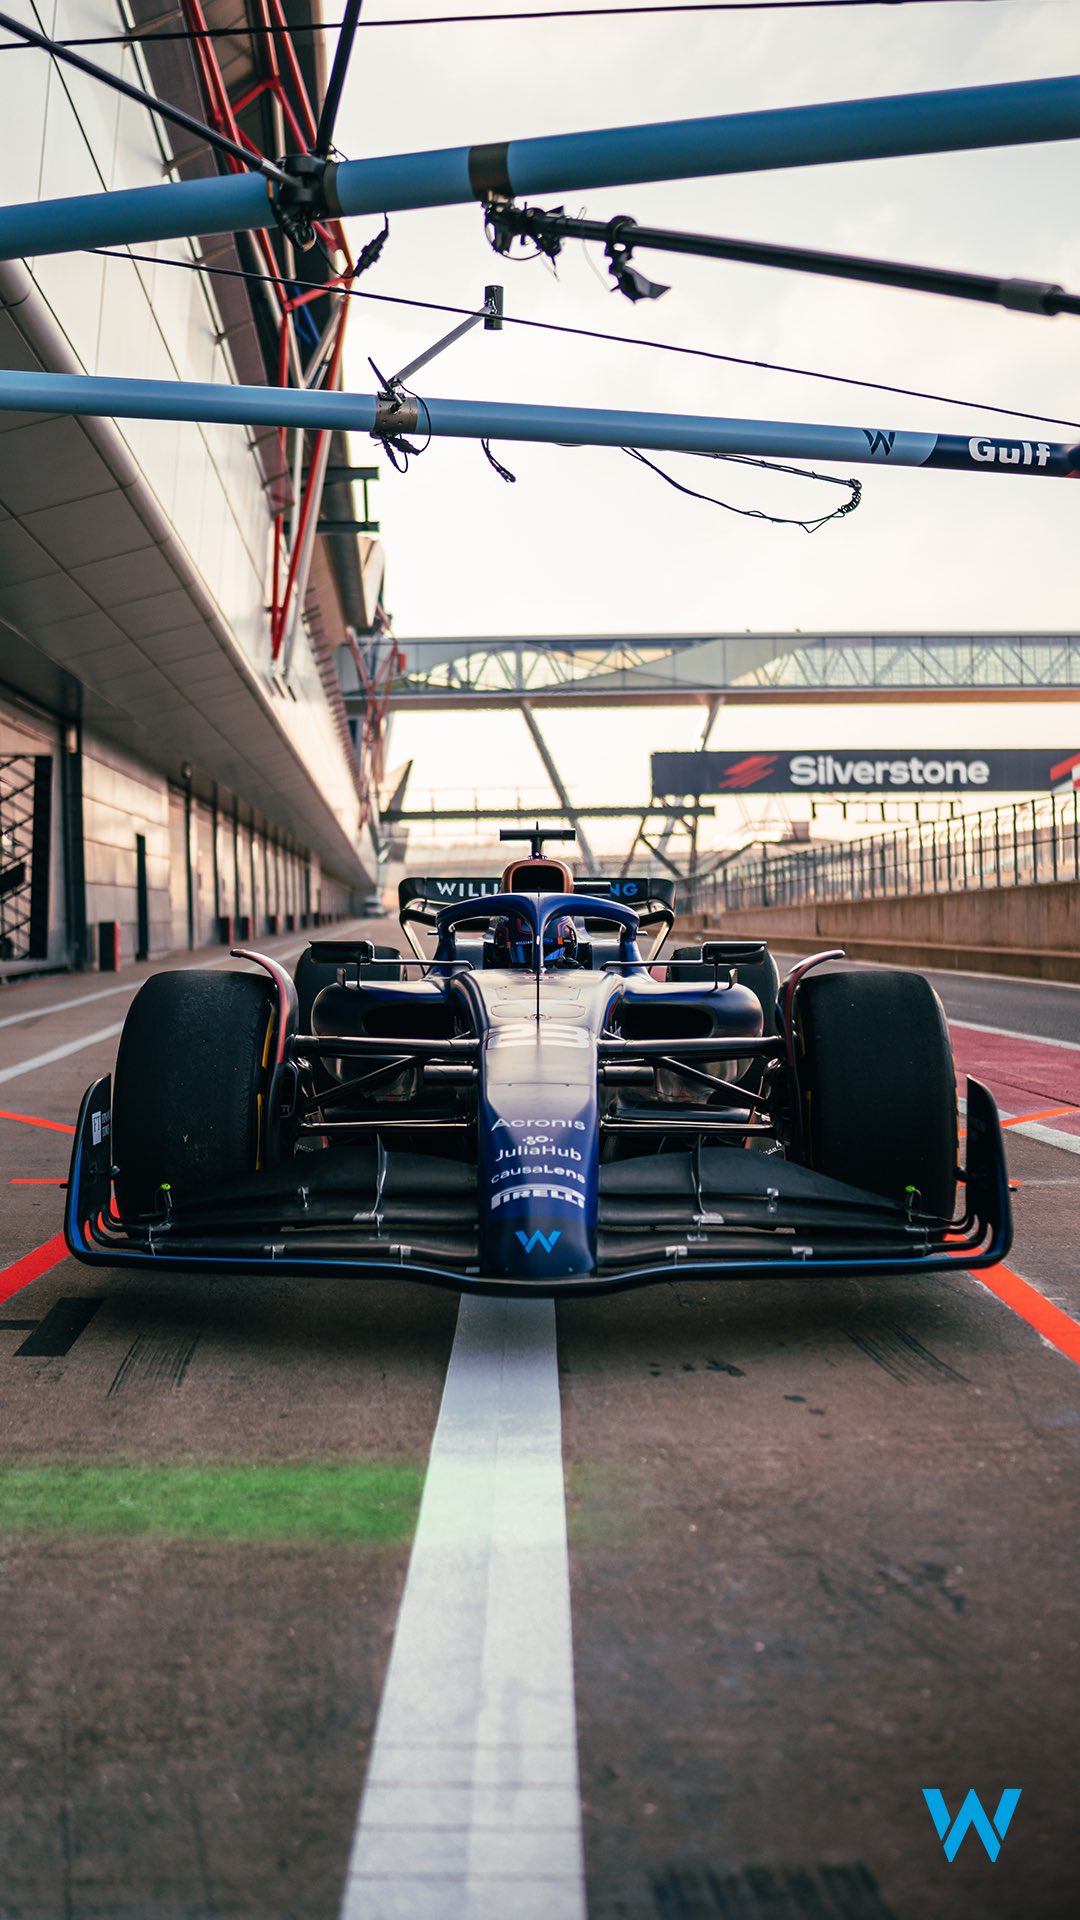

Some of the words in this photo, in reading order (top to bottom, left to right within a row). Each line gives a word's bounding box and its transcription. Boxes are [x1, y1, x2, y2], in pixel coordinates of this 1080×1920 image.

[968, 437, 1051, 467] Gulf
[789, 755, 990, 786] Silverstone
[437, 882, 500, 897] WILLI
[491, 1118, 586, 1132] Acronis
[495, 1145, 582, 1162] JuliaHub
[491, 1164, 586, 1184] causaLens
[491, 1183, 586, 1211] PIRELLI
